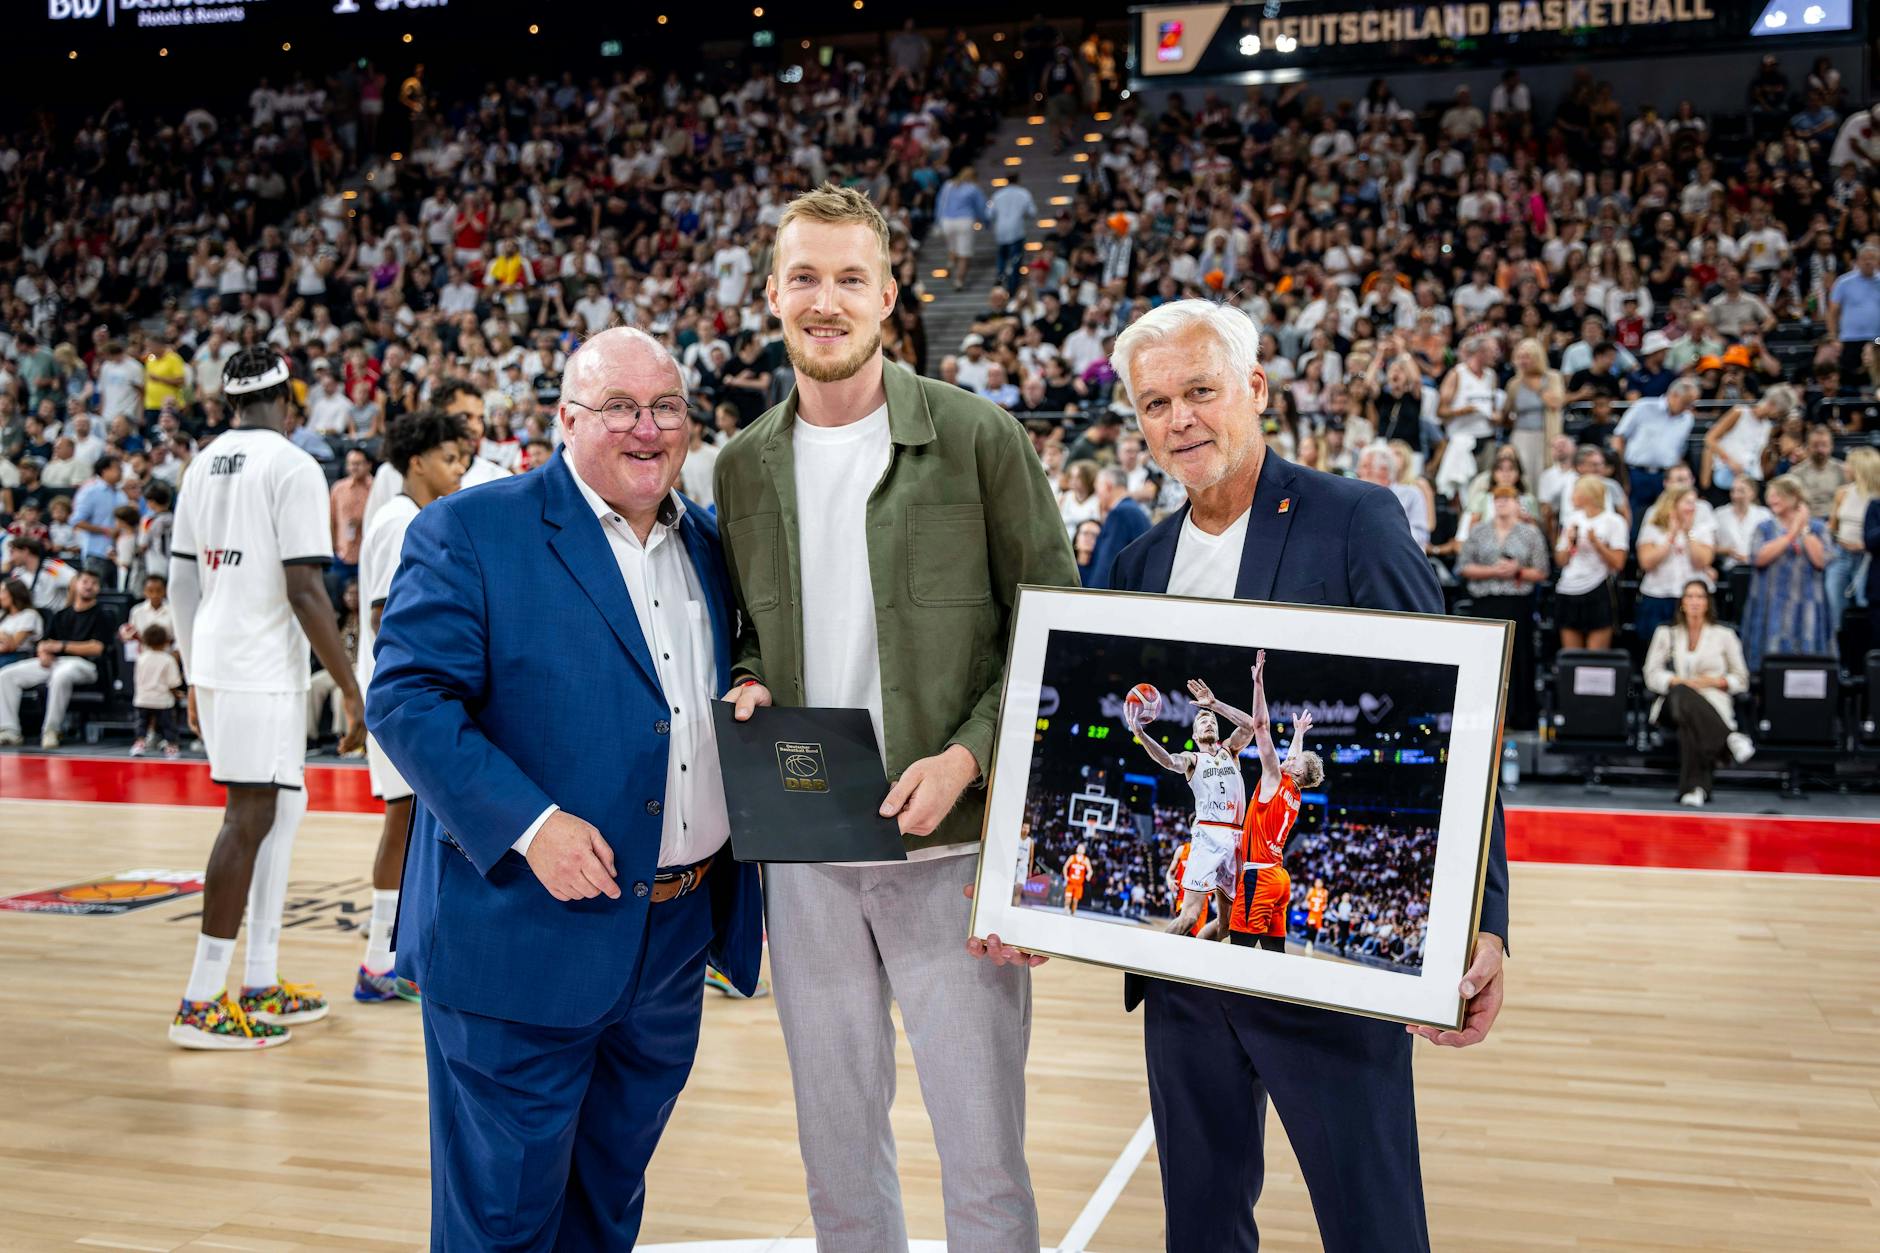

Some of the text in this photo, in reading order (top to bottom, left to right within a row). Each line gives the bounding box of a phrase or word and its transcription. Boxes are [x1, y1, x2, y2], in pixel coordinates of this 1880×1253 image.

[137, 8, 181, 28] Hotels
[195, 5, 246, 23] Resorts
[1499, 0, 1715, 34] BASKETBALL
[1219, 781, 1226, 794] 5
